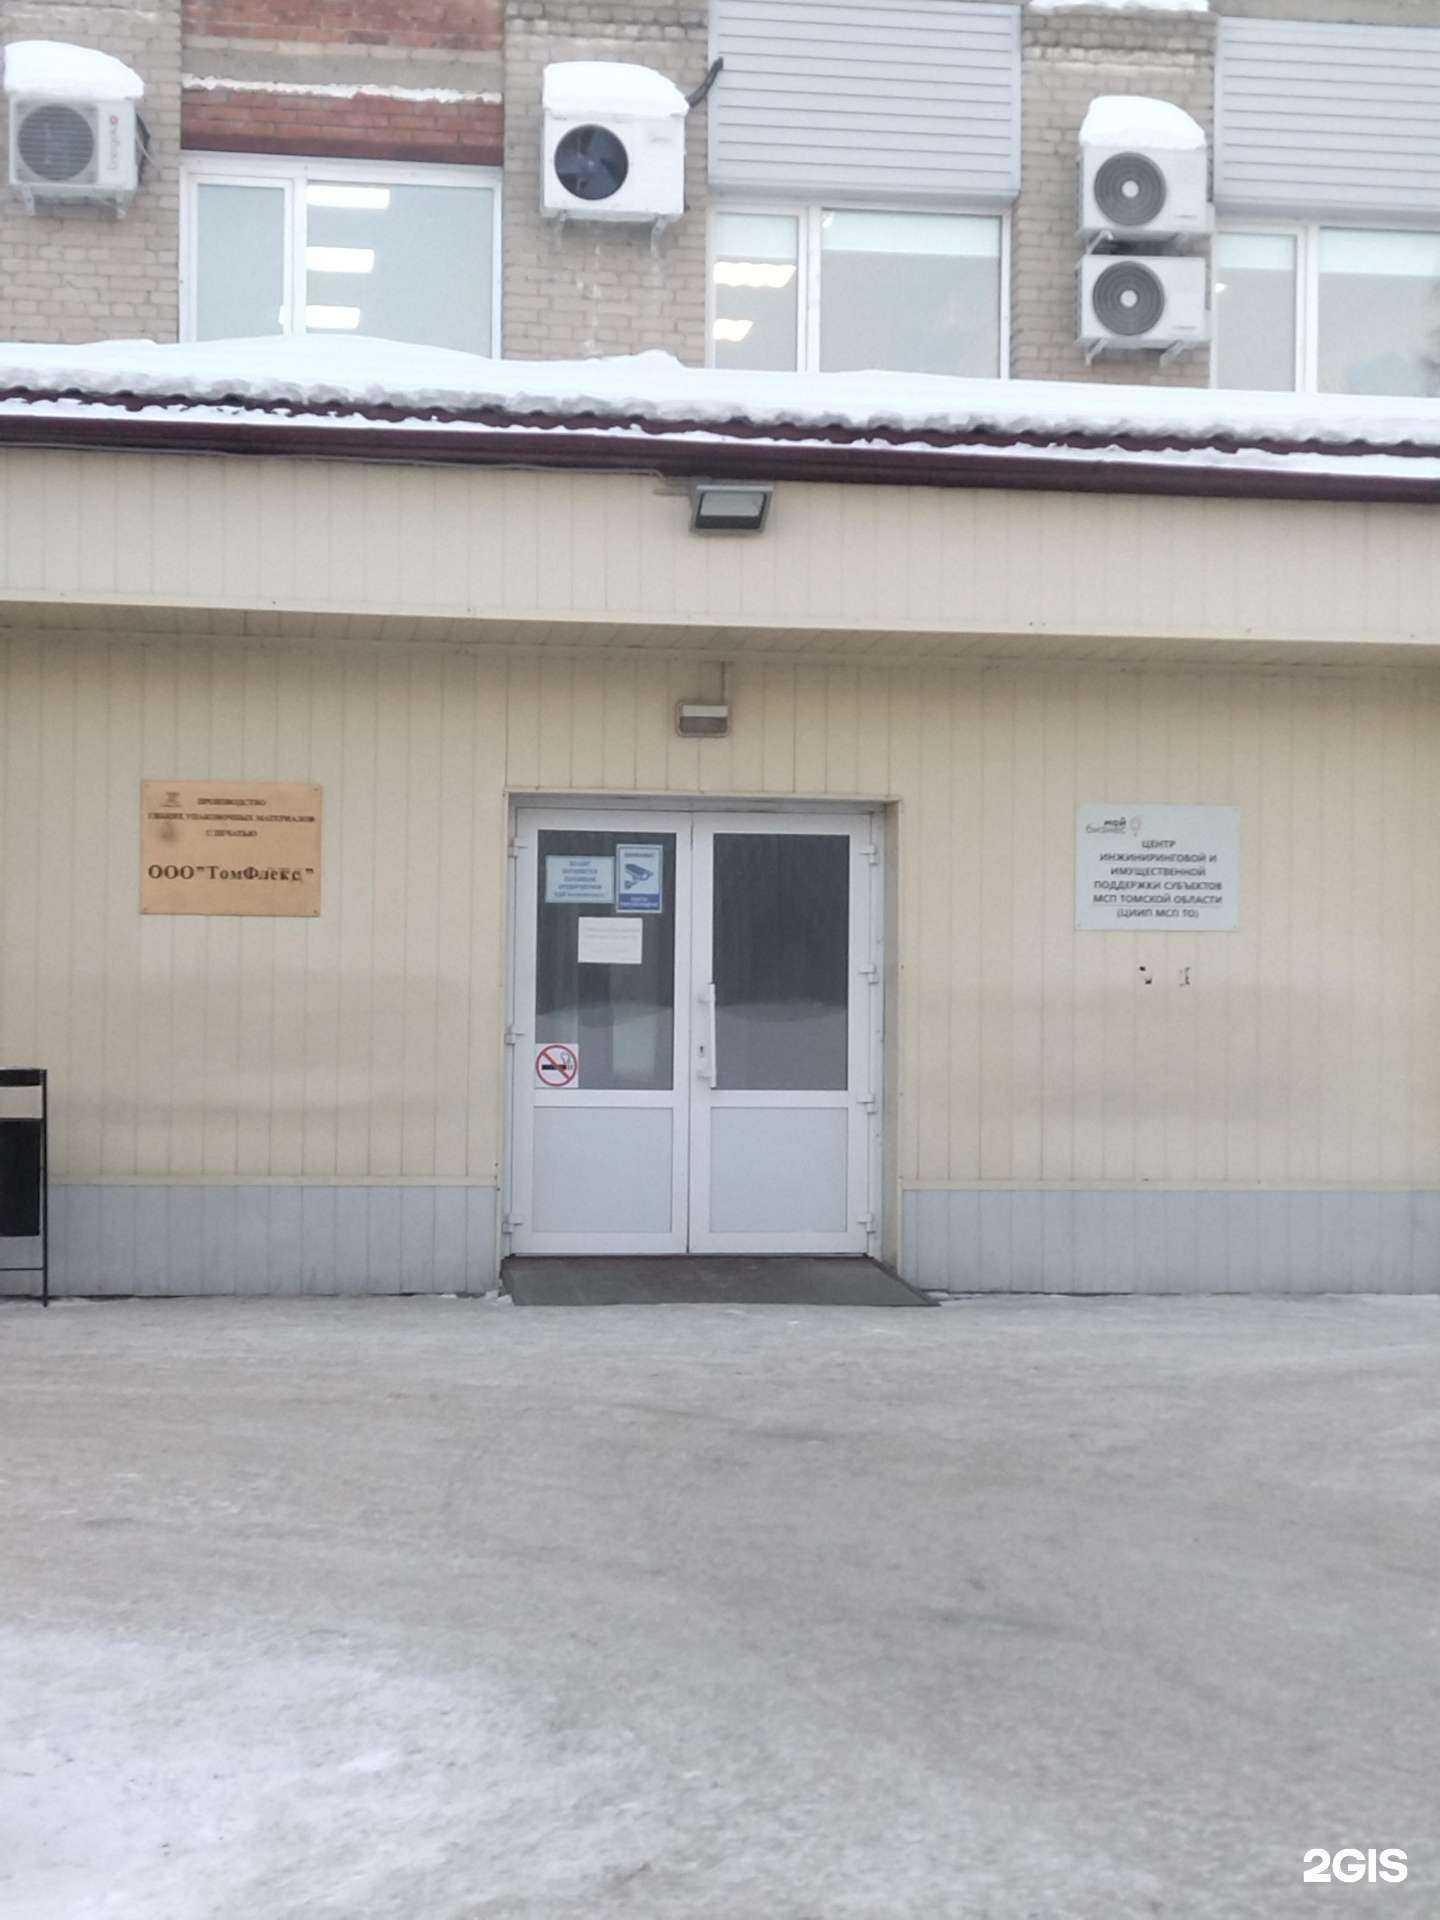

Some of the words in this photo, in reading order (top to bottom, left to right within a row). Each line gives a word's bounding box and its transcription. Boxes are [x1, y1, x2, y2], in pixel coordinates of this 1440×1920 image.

[1141, 840, 1176, 849] ЦЕНТР
[1099, 853, 1207, 863] ИНЖИНИРИНГОВОЙ
[1208, 854, 1217, 863] И
[1110, 866, 1206, 877] ИМУЩЕСТВЕННОЙ
[1093, 880, 1161, 891] ПОДДЕРЖКИ
[1163, 881, 1223, 890] СУБЪЕКТОВ
[1092, 894, 1118, 904] МСП
[1120, 893, 1171, 904] ТОМСКОЙ
[1173, 894, 1223, 904] ОБЛАСТИ
[1116, 908, 1153, 918] (ЦИИП
[1155, 909, 1180, 918] МСП
